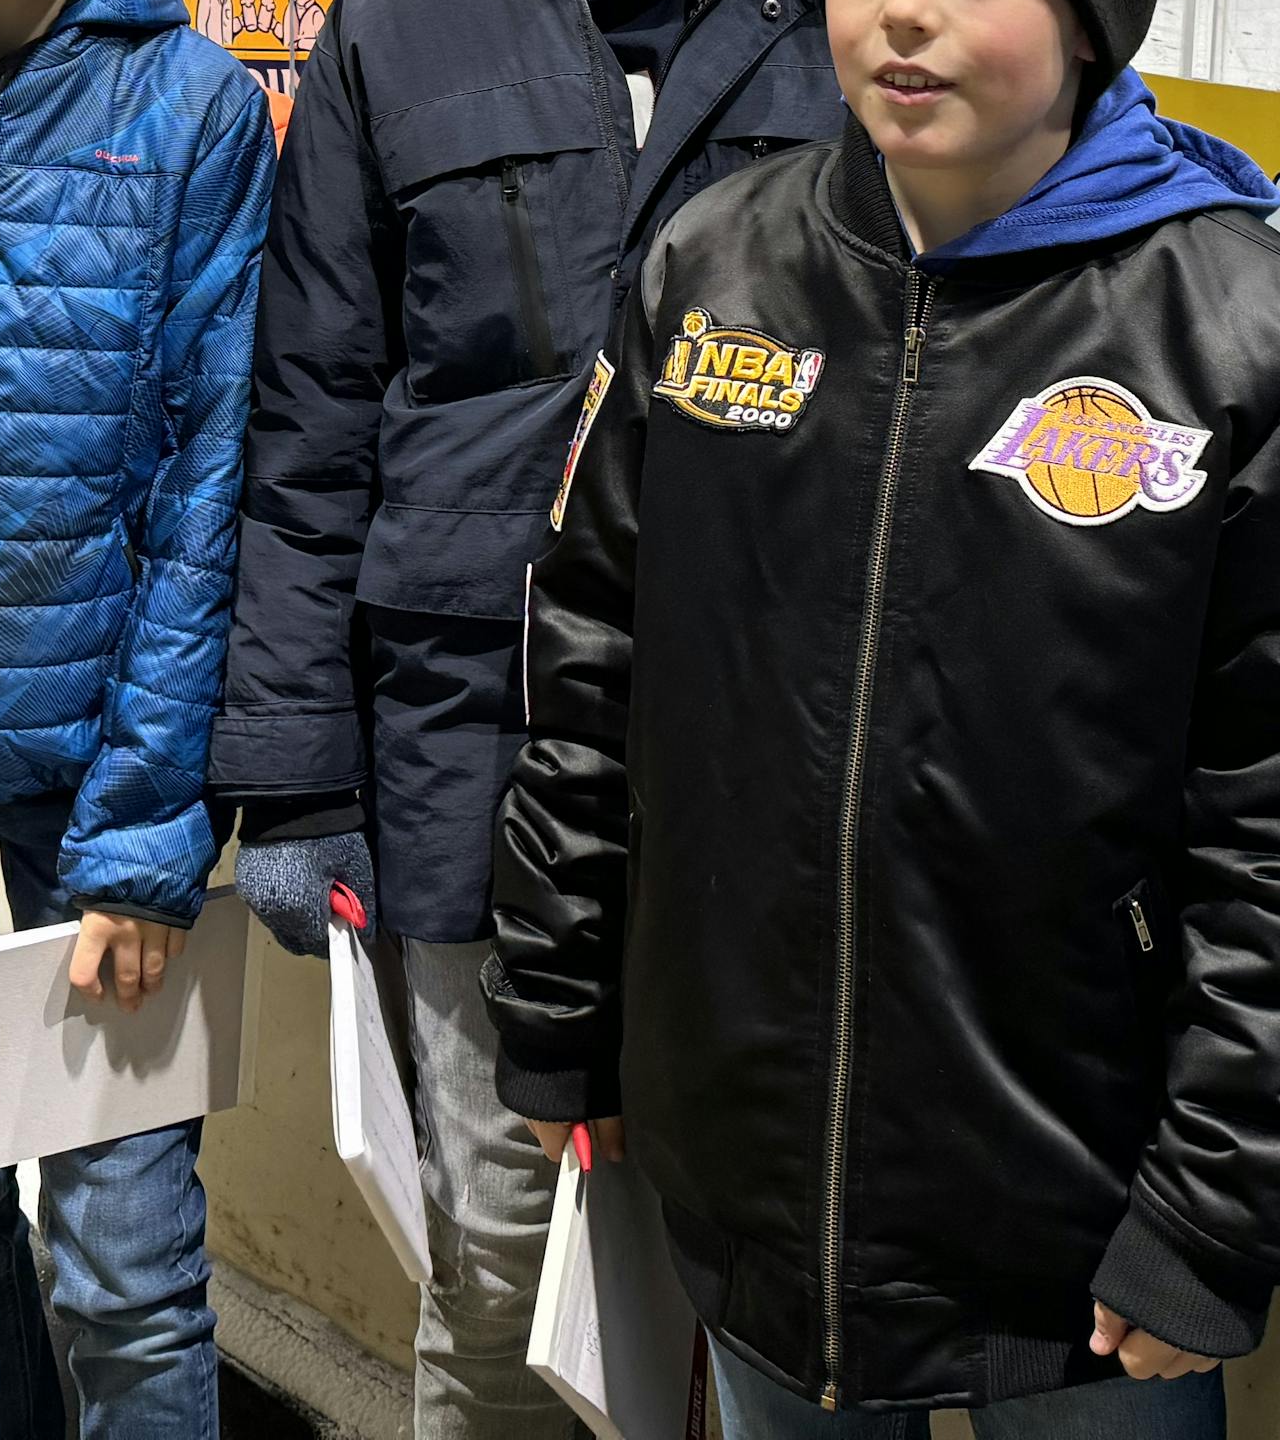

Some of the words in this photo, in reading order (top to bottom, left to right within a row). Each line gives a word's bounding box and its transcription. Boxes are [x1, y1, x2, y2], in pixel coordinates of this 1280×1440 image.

[692, 340, 796, 388] NBA
[688, 374, 804, 413] FINALS
[724, 405, 792, 428] 2000
[984, 404, 1195, 503] LAKERS
